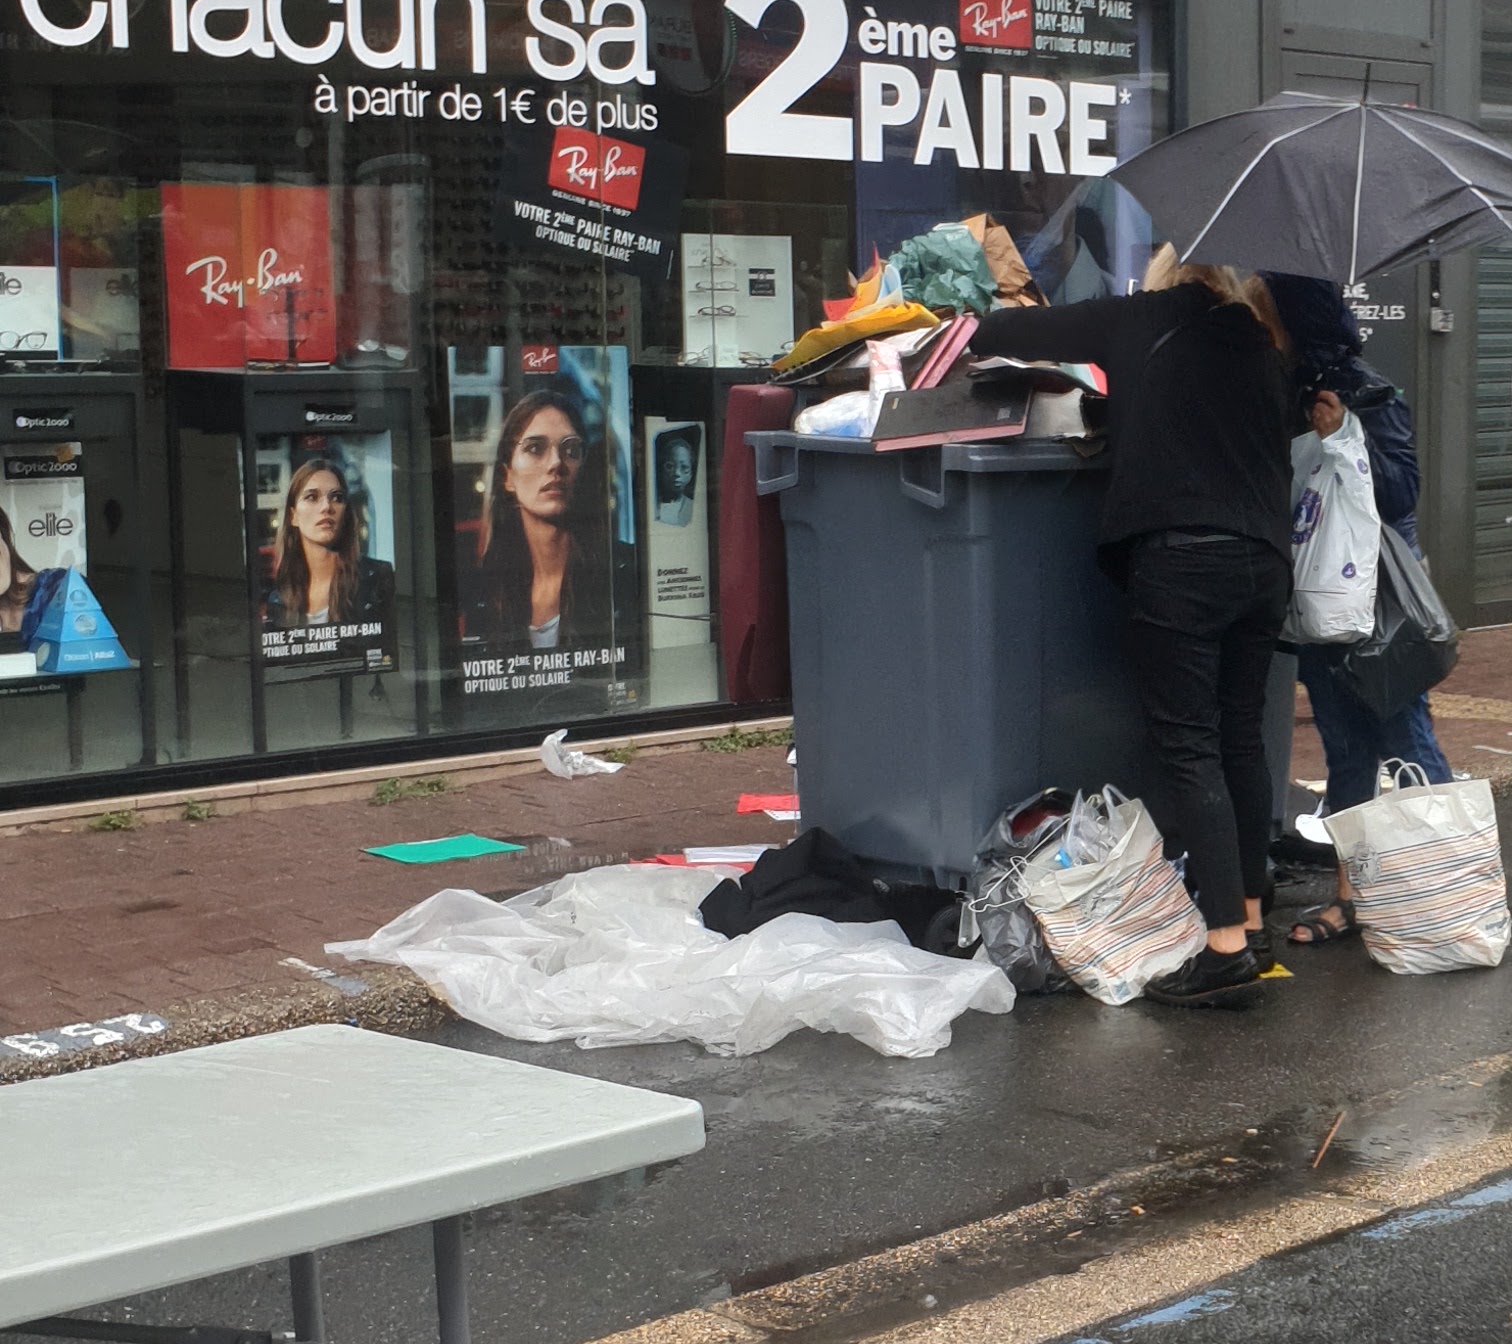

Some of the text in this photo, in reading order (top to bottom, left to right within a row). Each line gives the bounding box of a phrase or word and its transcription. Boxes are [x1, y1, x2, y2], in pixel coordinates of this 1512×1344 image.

[1035, 12, 1085, 35] RAY-BAN
[1035, 34, 1077, 54] OPTIQUE
[1078, 38, 1092, 55] OU
[314, 74, 658, 136] à partir de 1€ de plus
[558, 145, 638, 190] Ray-Ban
[514, 200, 551, 224] VOTRE
[576, 218, 610, 242] PAIRE
[613, 228, 662, 255] RAY-BAN
[535, 225, 576, 247] OPTIQUE
[577, 238, 592, 251] OU
[28, 512, 74, 537] elite
[262, 630, 286, 647] OTRE
[308, 625, 338, 642] PAIRE
[340, 622, 382, 638] RAY-BAN
[262, 644, 290, 658] TIQUE
[291, 643, 303, 656] OU
[463, 658, 504, 678] VOTRE
[534, 652, 571, 672] PAIRE
[574, 646, 625, 668] RAY-BAN
[464, 678, 510, 694] OPTIQUE
[511, 675, 526, 690] OU
